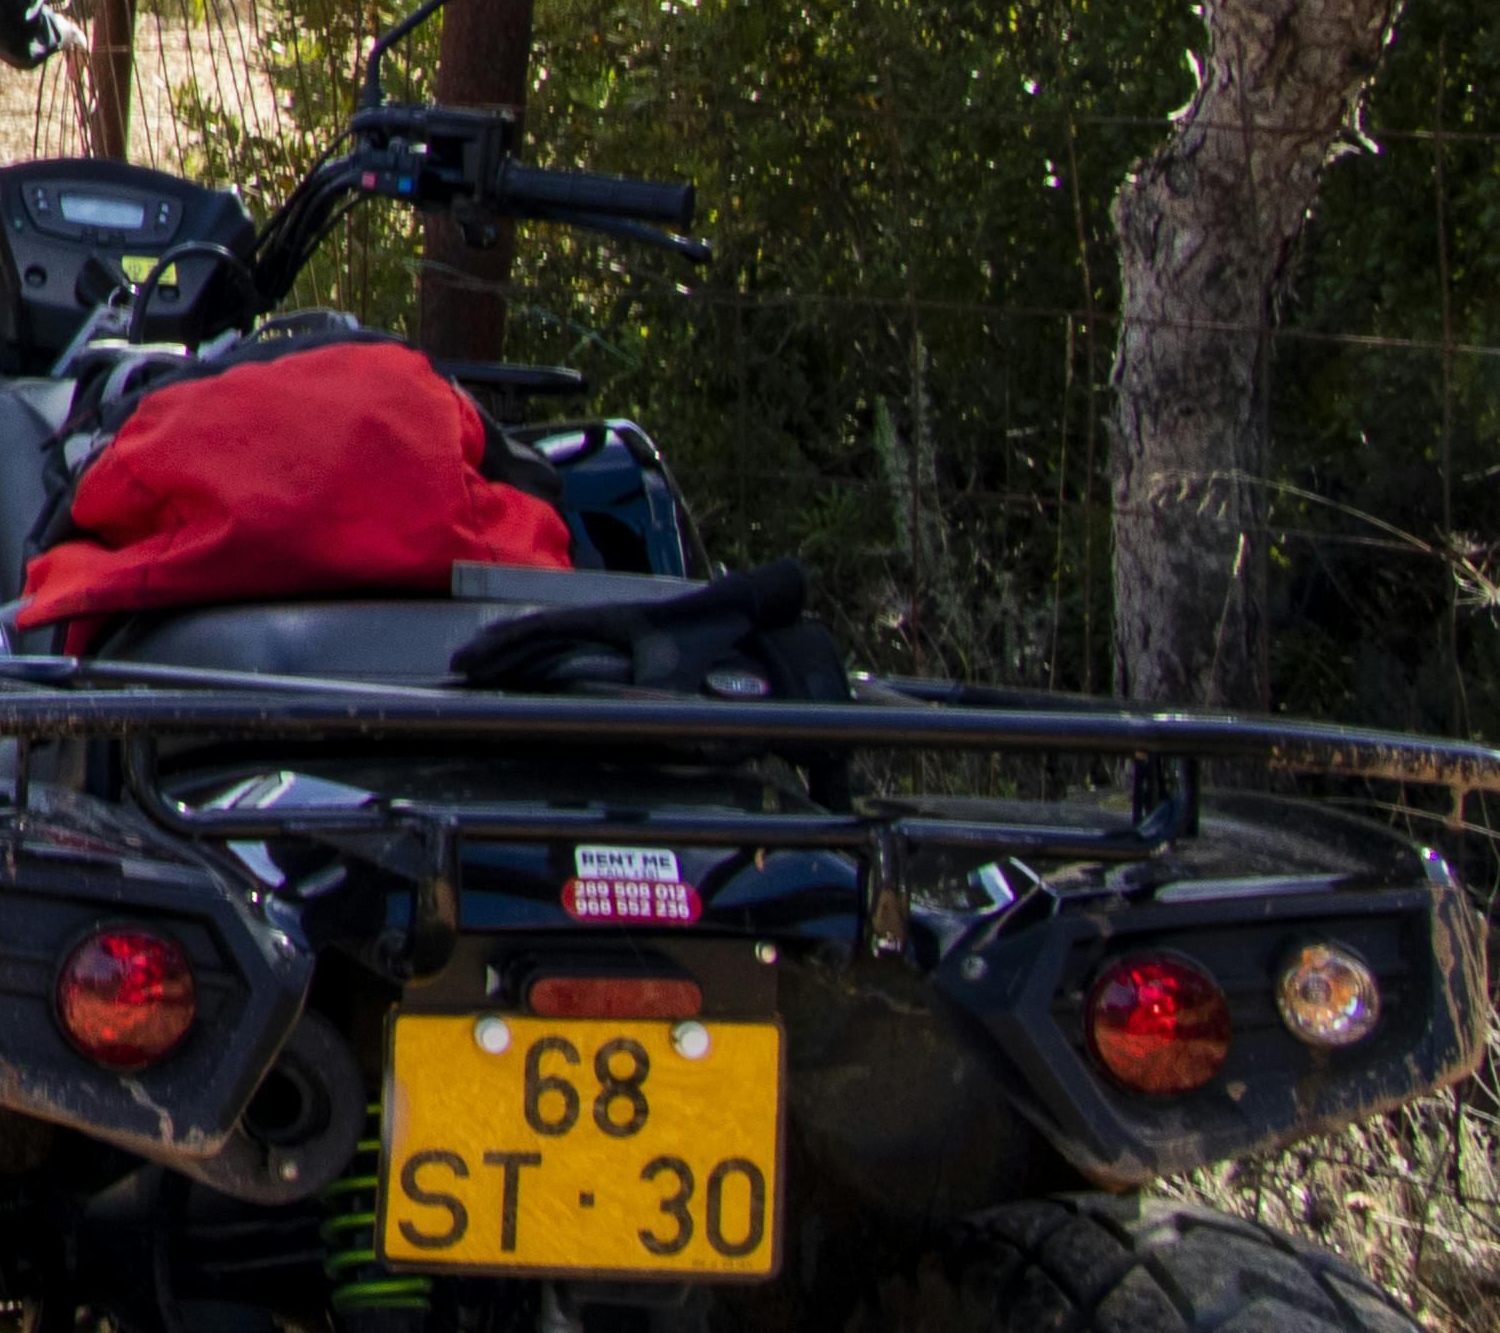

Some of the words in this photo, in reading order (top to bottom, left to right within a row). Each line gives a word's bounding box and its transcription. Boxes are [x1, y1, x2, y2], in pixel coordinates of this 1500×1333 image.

[581, 851, 635, 867] RENT
[642, 854, 671, 868] ME
[524, 1036, 650, 1138] 68
[398, 1149, 542, 1253] ST
[638, 1154, 765, 1258] 30
